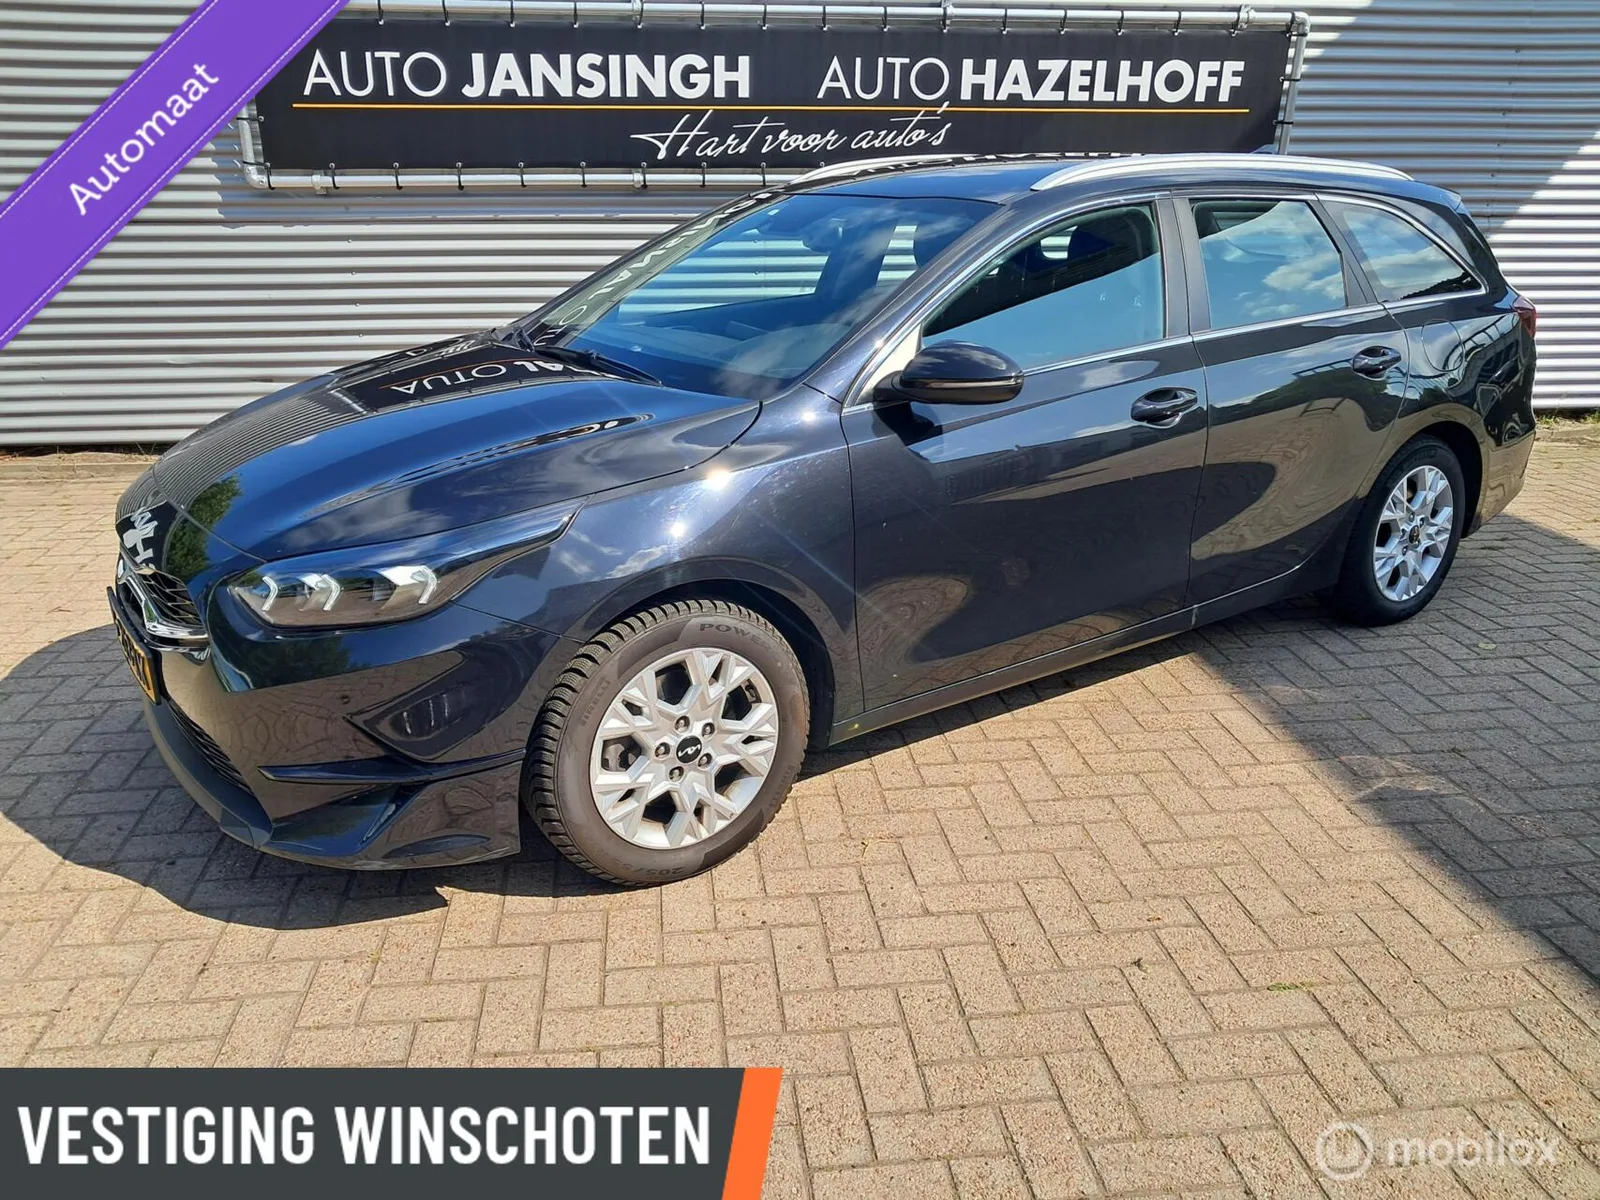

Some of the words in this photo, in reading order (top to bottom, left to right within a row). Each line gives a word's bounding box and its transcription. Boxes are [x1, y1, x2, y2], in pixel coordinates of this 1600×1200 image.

[303, 49, 447, 97] AUTO
[462, 52, 750, 99] JANSINGH
[817, 56, 950, 100] AUTO
[961, 59, 1245, 102] HAZELHOFF
[630, 109, 785, 160] Hart
[758, 129, 847, 154] voor
[850, 101, 953, 150] auto's
